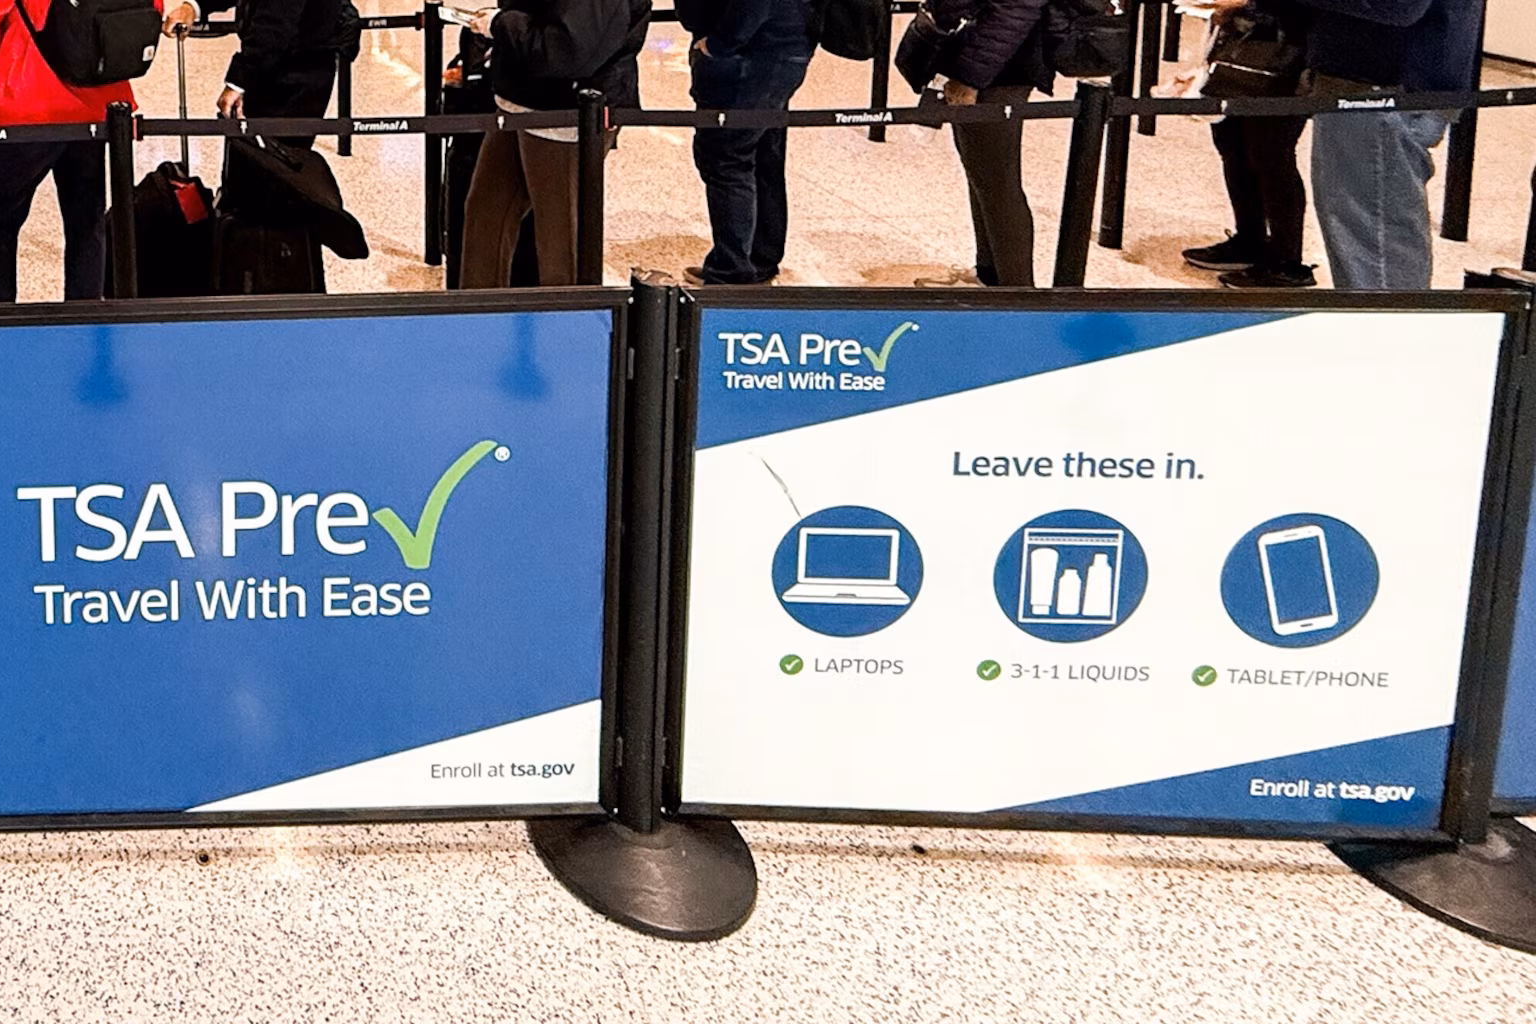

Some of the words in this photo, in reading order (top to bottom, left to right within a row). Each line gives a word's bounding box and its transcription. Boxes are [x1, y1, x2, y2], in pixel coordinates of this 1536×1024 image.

[1337, 98, 1386, 109] Terminal
[1385, 97, 1395, 108] A
[353, 120, 399, 131] Terminal
[399, 120, 408, 130] A
[835, 112, 883, 123] Terminal
[883, 111, 893, 122] A
[718, 332, 791, 365] TSA
[799, 333, 862, 366] Pre
[722, 371, 783, 390] Travel
[788, 371, 835, 390] With
[839, 369, 886, 391] Ease
[953, 451, 1053, 478] Leave
[1062, 451, 1155, 479] these
[1165, 452, 1204, 480] in.
[17, 483, 196, 562] TSA
[222, 481, 369, 557] Pre
[33, 579, 179, 625] Travel
[195, 576, 306, 620] With
[323, 577, 431, 617] Ease
[814, 658, 904, 675] LAPTOPS
[1011, 663, 1060, 680] 3-1-1
[1068, 664, 1150, 683] LIQUIDS
[1227, 668, 1389, 688] TABLET/PHONE
[430, 762, 482, 779] Enroll
[487, 763, 505, 778] at
[510, 762, 575, 779] tsa.gov
[1249, 778, 1310, 798] Enroll
[1313, 781, 1337, 799] at
[1338, 781, 1416, 803] tsa.gov
